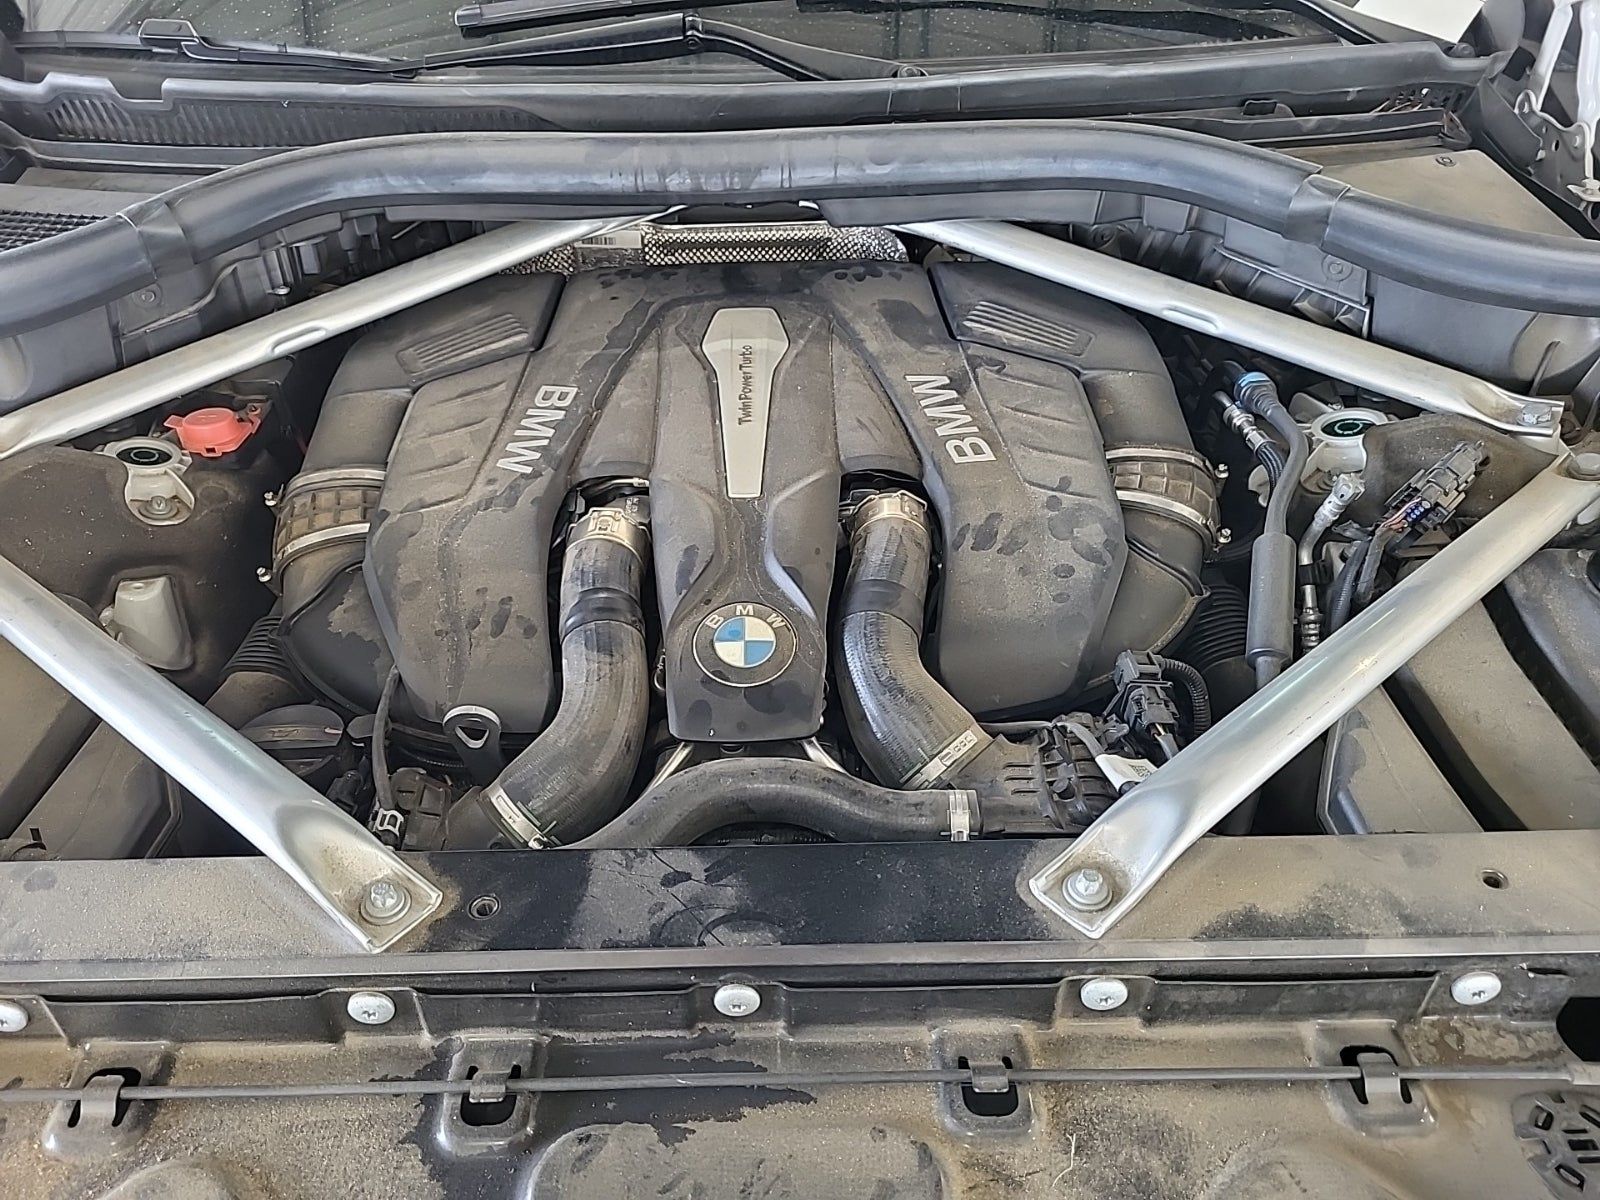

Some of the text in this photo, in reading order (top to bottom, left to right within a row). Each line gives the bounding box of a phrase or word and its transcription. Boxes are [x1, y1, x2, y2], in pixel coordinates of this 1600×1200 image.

[496, 385, 579, 474] BMW
[904, 375, 997, 464] BMW
[704, 604, 787, 630] BMW
